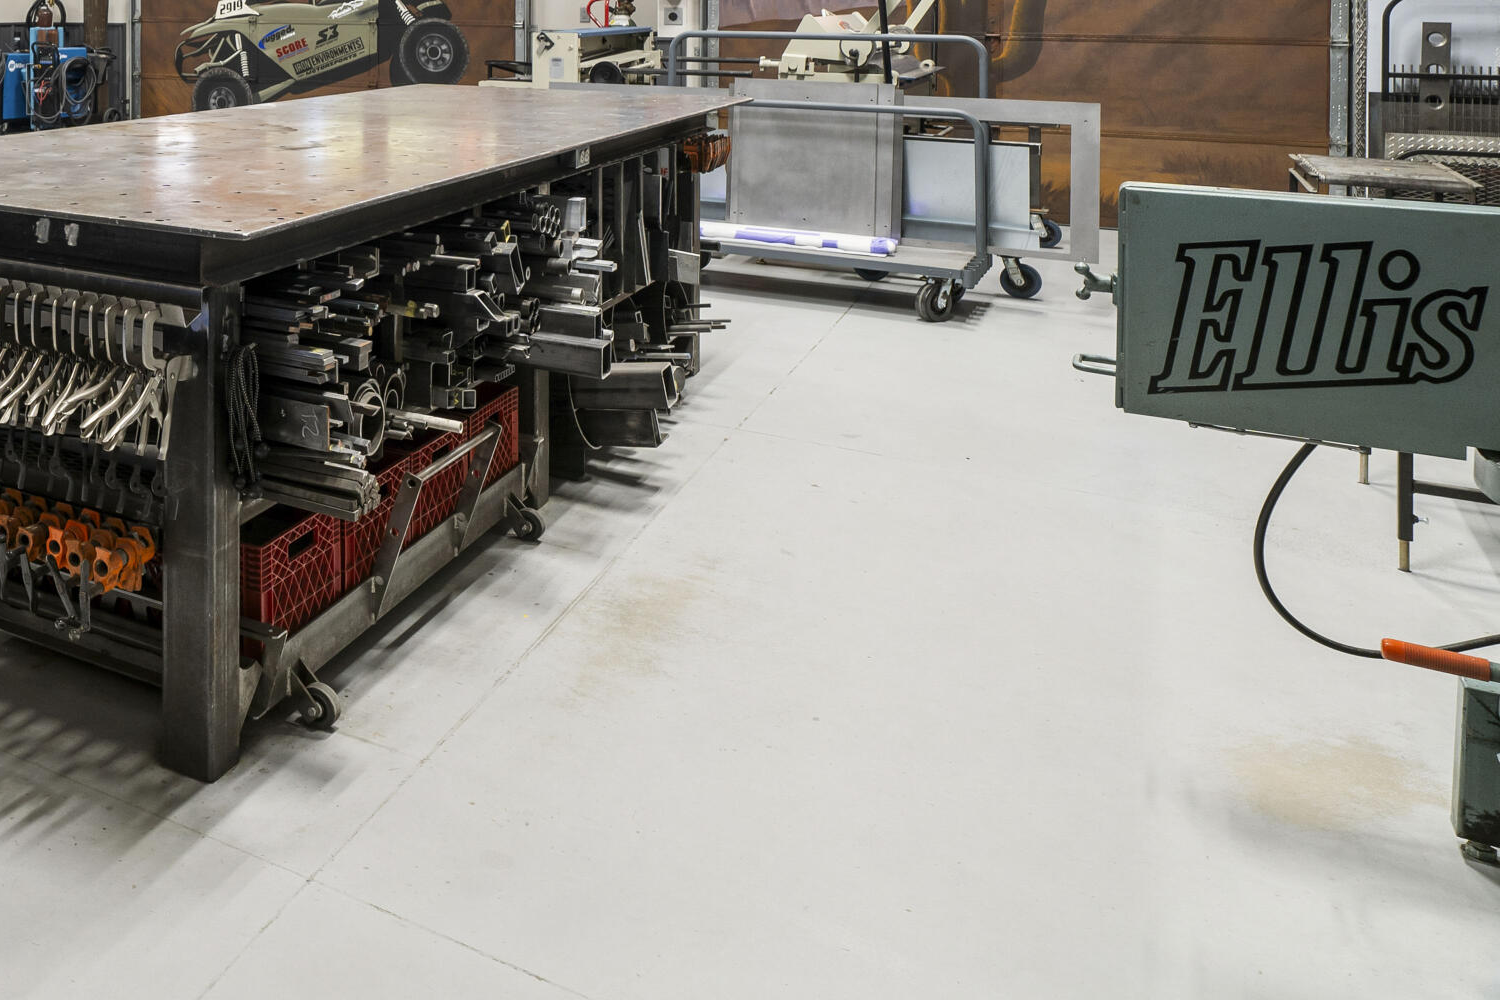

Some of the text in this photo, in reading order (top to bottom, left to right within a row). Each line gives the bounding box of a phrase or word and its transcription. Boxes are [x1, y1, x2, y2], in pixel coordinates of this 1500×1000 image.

[220, 0, 243, 15] 2919
[262, 24, 293, 43] rugged
[276, 37, 309, 58] SCORE
[294, 58, 312, 73] IRON
[311, 38, 362, 66] ENVIRONMENTS
[1147, 239, 1488, 395] Ellis
